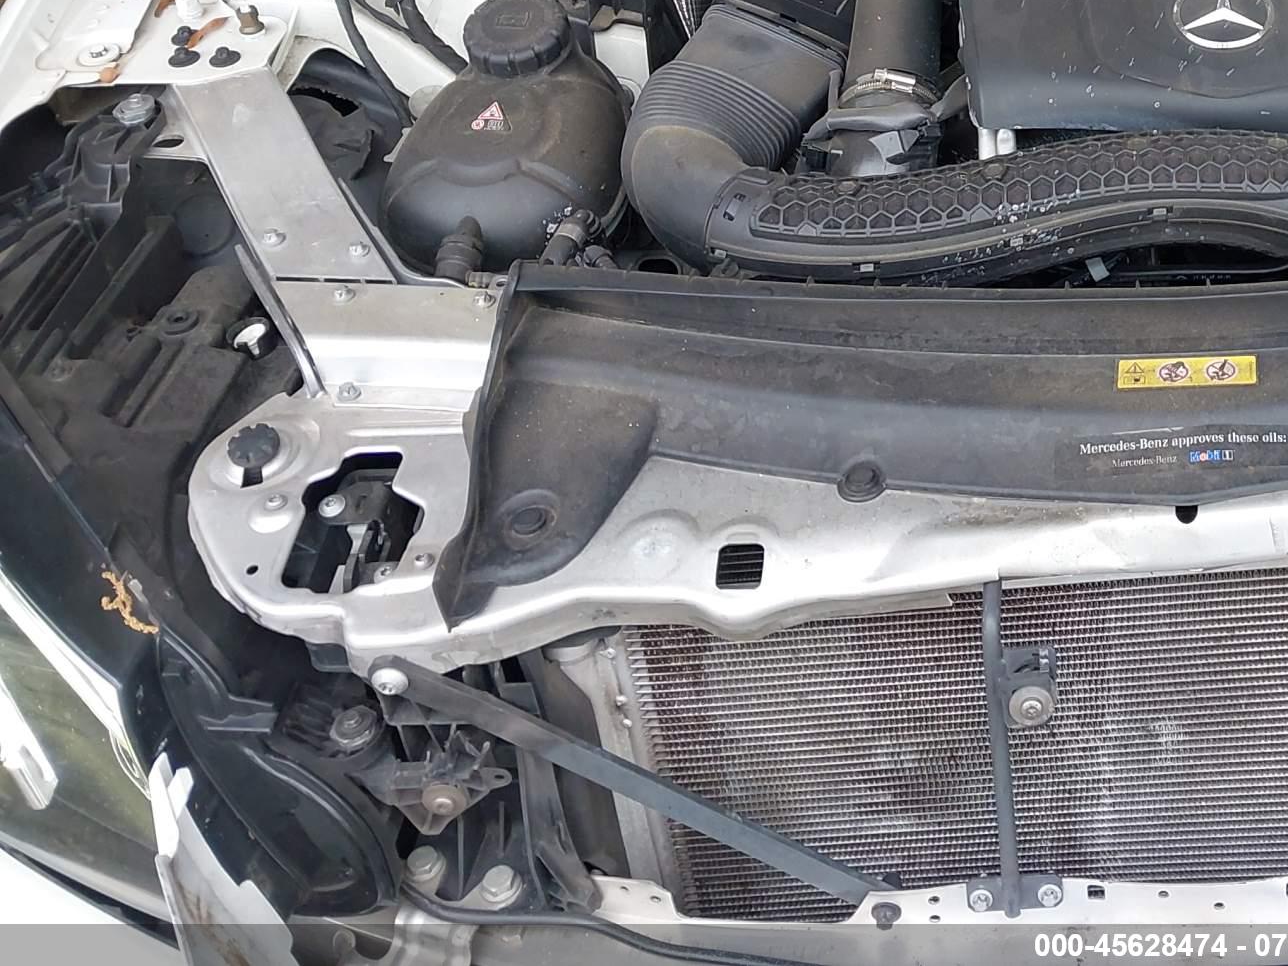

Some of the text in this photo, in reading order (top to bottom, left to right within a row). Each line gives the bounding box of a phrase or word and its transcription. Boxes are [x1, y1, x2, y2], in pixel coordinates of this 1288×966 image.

[1080, 432, 1287, 455] Mercedes-Benz approves these oils:
[1111, 454, 1178, 468] Mercedes-Benz
